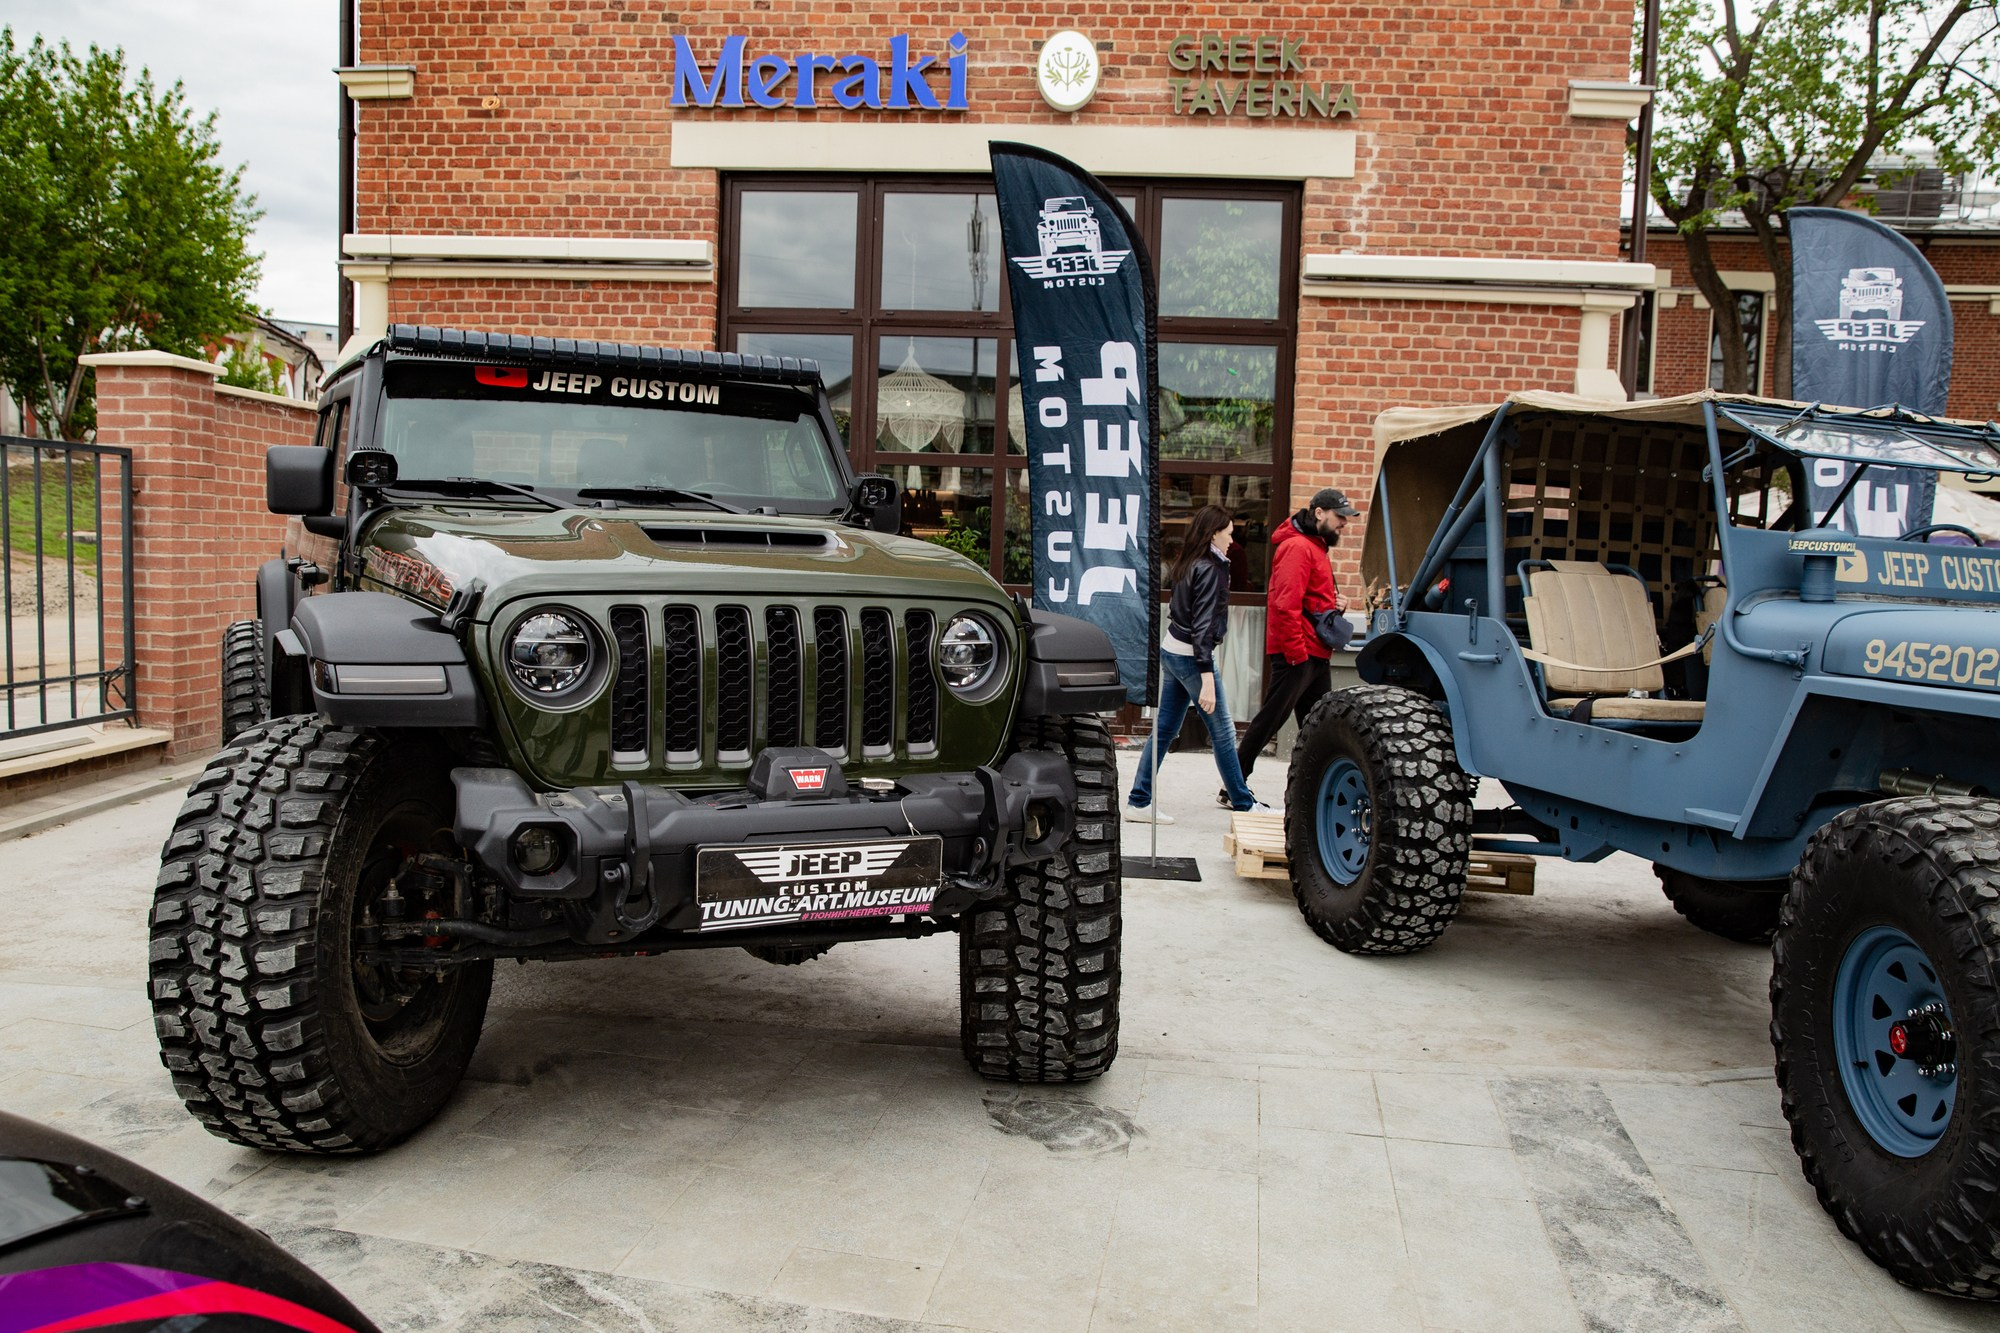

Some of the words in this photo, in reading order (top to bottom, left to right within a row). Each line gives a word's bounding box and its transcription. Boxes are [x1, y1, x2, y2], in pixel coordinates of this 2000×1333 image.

[670, 31, 970, 111] Meraki
[1167, 35, 1305, 73] GREEK
[1168, 78, 1360, 118] TAVERNA
[532, 371, 602, 395] JEEP
[610, 377, 720, 405] CUSTOM
[368, 546, 453, 599] MOJAVE
[1877, 550, 1930, 588] JEEP
[1863, 638, 2000, 687] 945202
[796, 773, 821, 784] WARN
[786, 850, 862, 877] JEEP
[779, 880, 868, 896] CUSTOM
